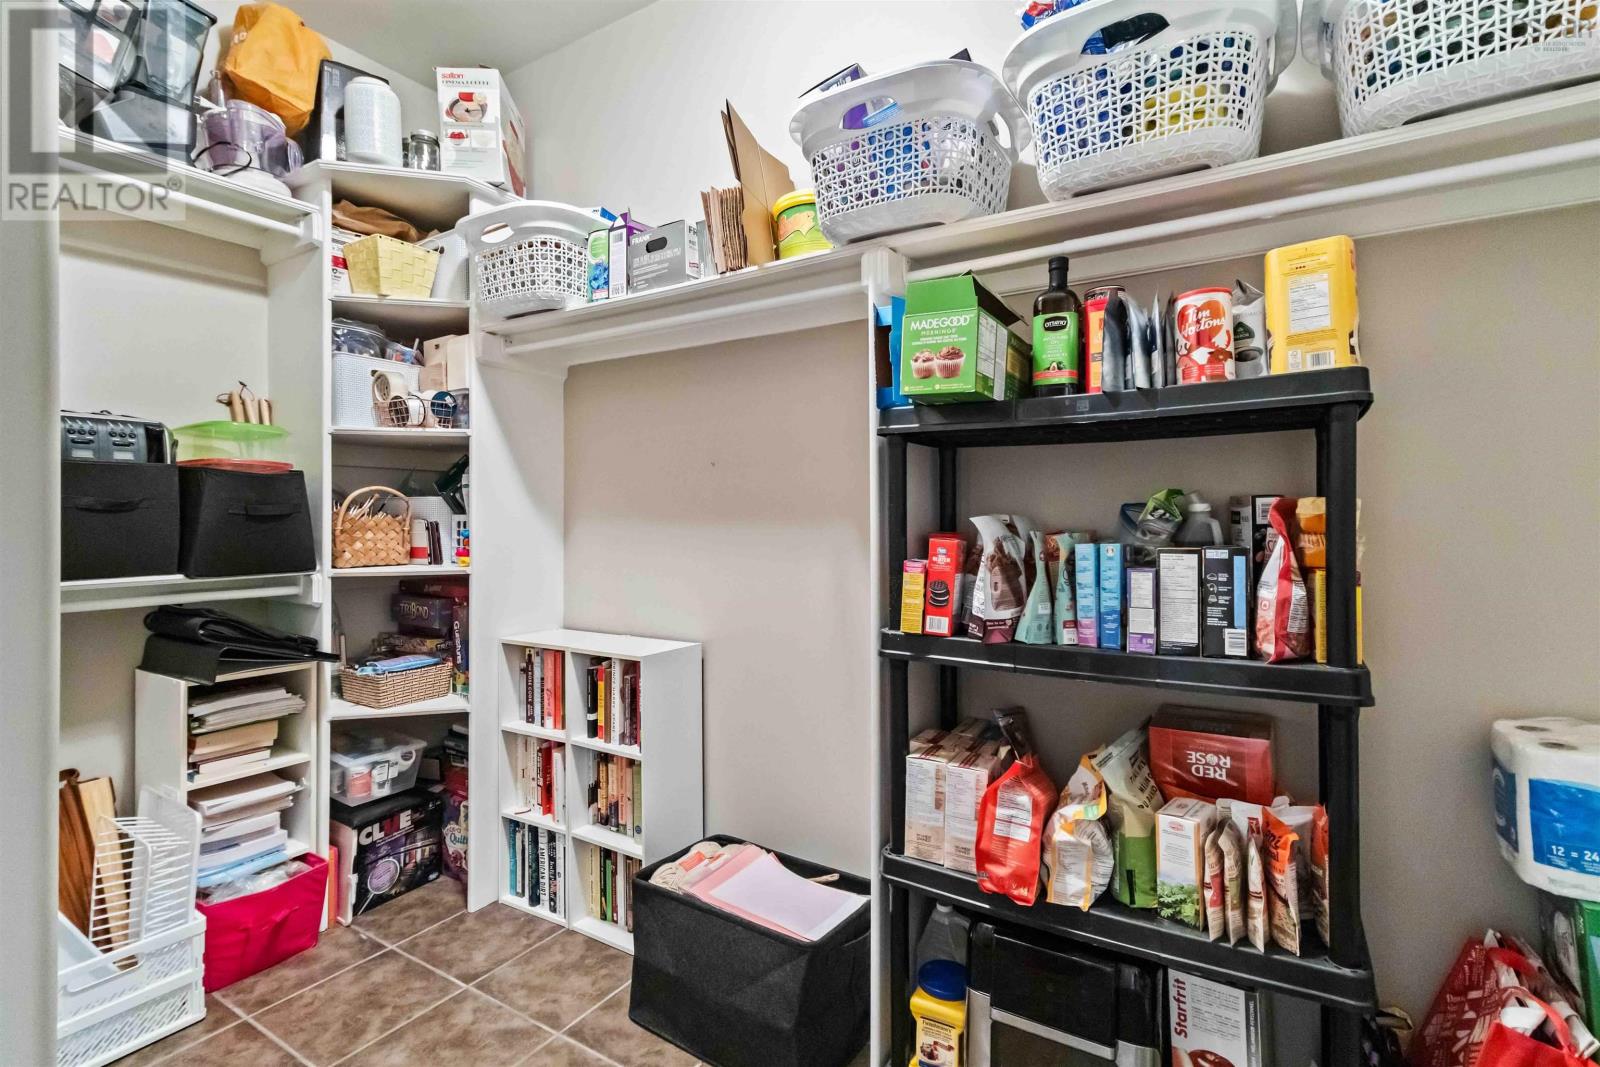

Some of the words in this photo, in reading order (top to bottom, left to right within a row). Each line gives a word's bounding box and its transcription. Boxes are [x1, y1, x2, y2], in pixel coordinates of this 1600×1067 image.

[910, 315, 970, 331] MADEGOOD
[1185, 307, 1210, 323] Tim
[1181, 317, 1226, 337] Hortons
[1191, 764, 1227, 781] RED
[358, 809, 412, 846] CLUE
[1551, 845, 1566, 857] 12
[1583, 850, 1600, 862] 24
[539, 847, 547, 880] AMERICAN
[1173, 977, 1188, 1040] Starfrit
